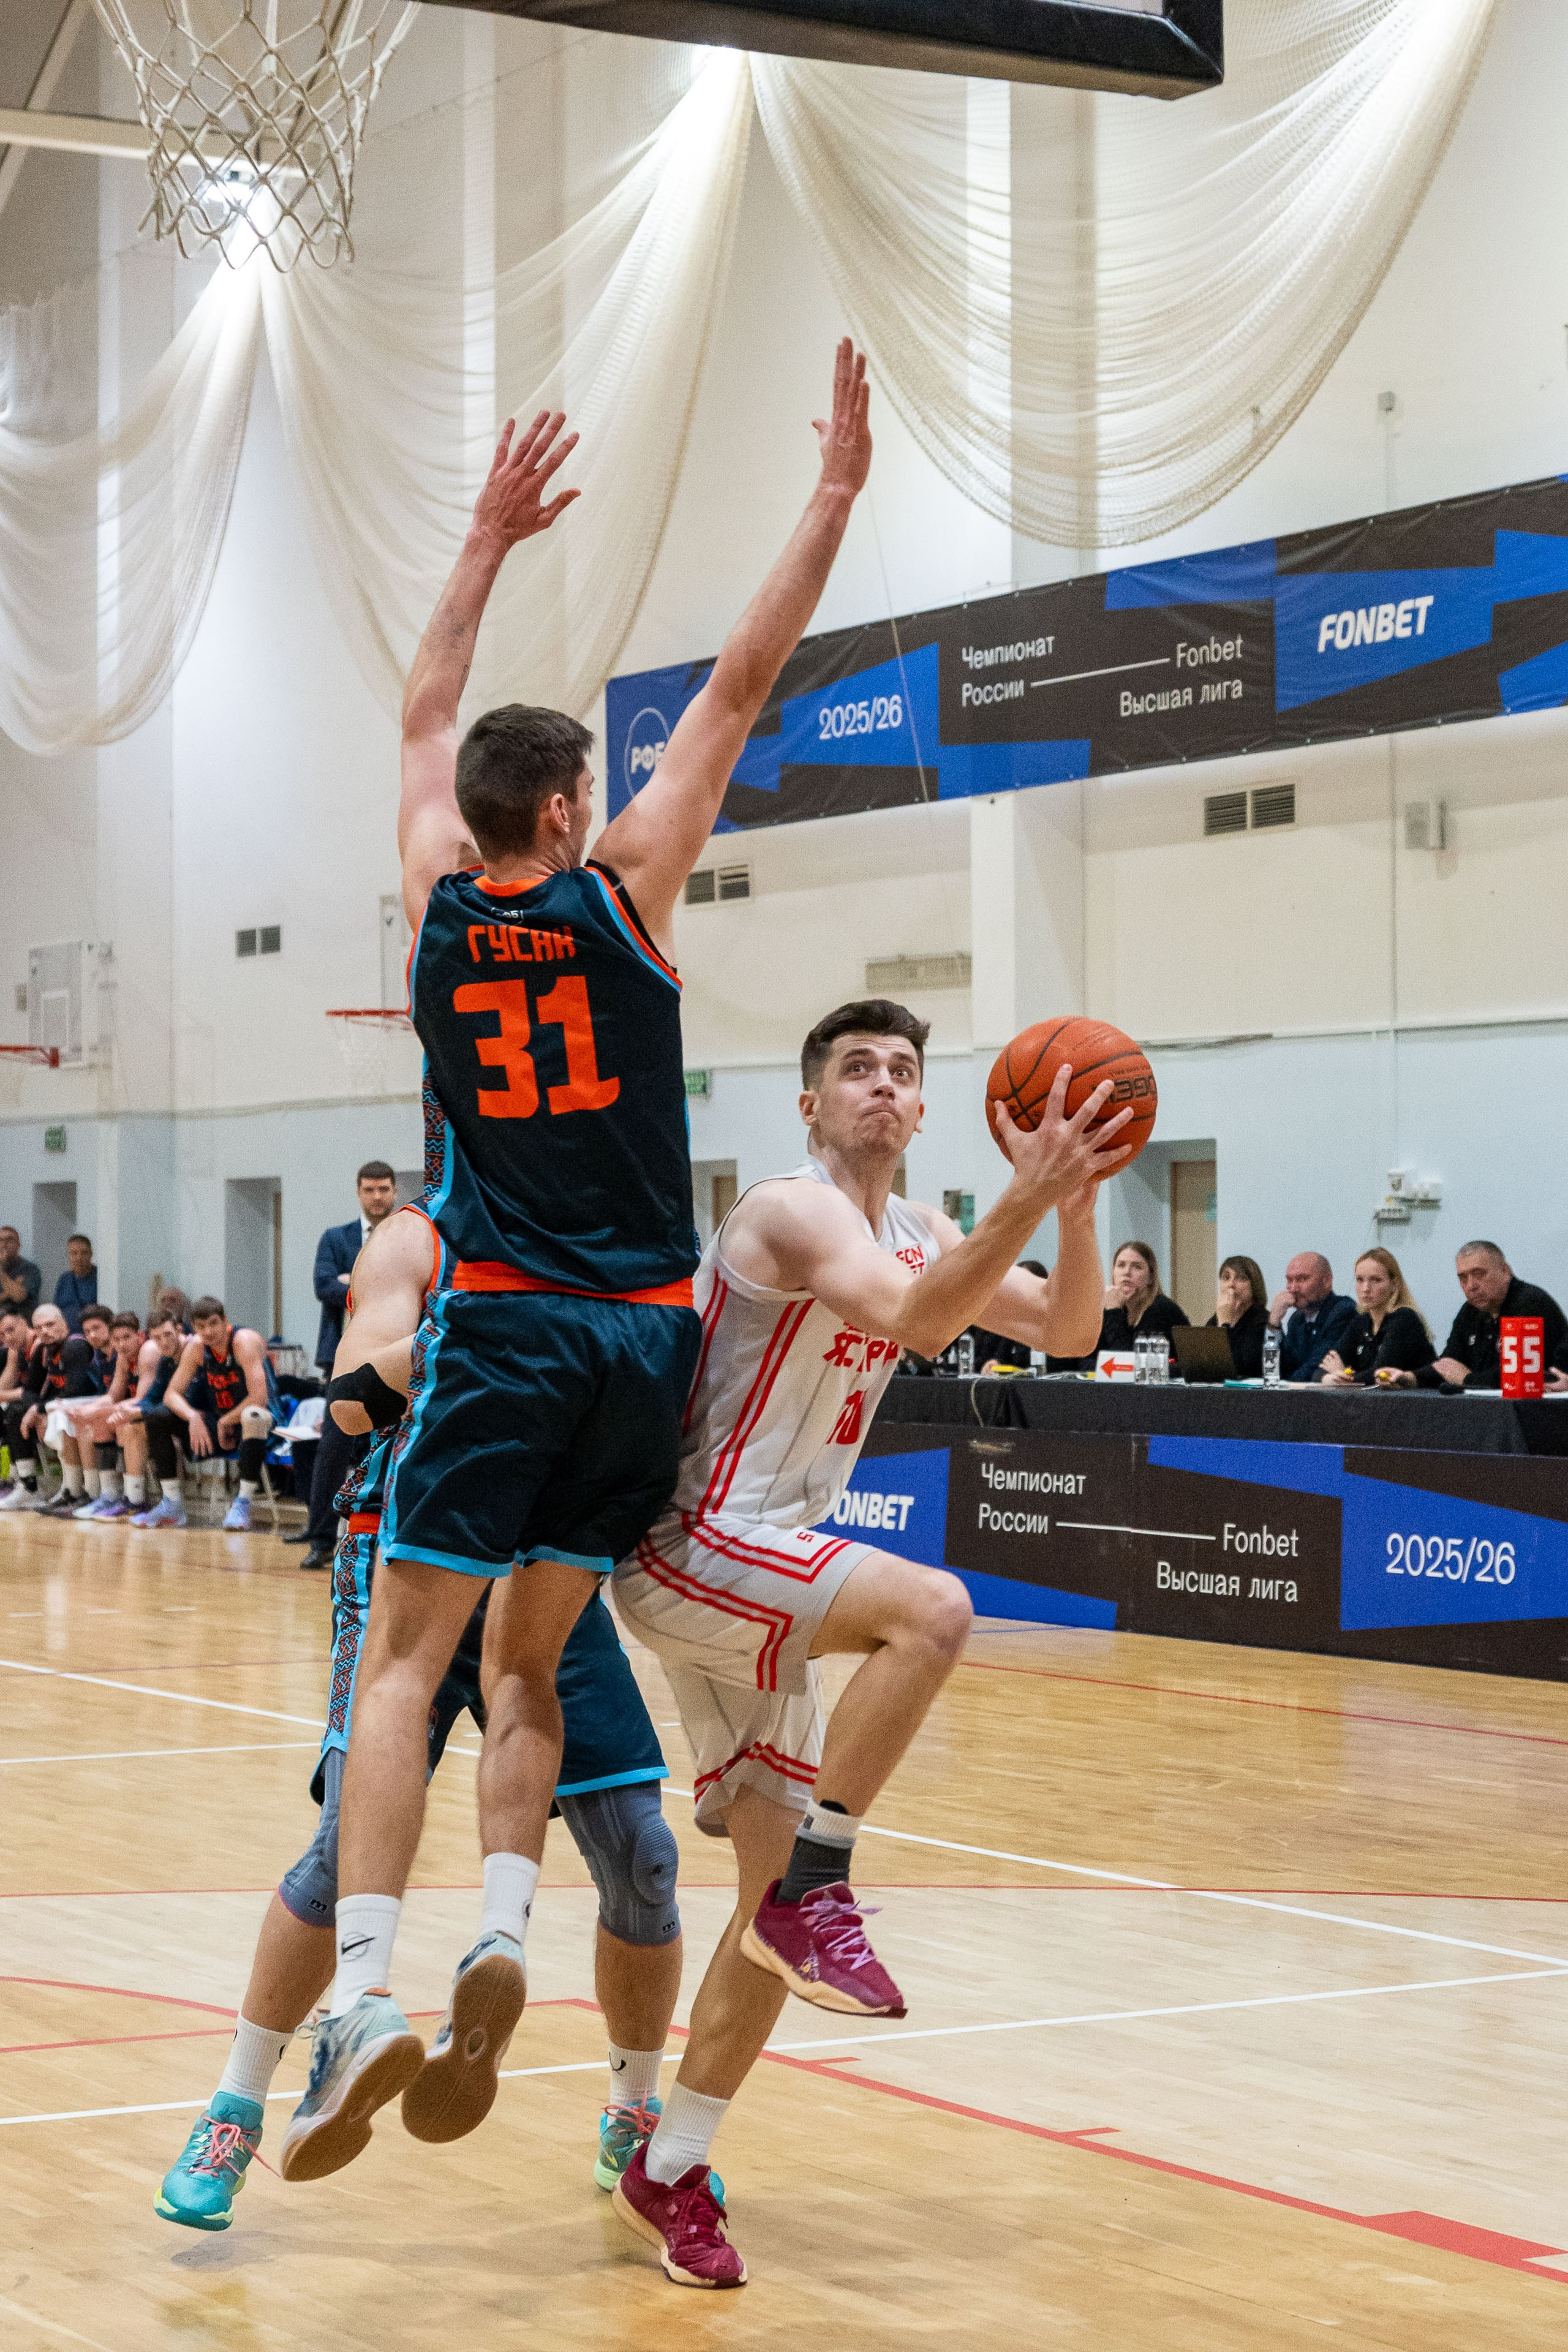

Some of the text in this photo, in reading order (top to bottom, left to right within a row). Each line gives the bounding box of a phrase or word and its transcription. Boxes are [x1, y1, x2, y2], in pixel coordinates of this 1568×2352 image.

[1317, 595, 1434, 653] FONBET
[962, 636, 1055, 669] Чемпионат
[1176, 633, 1243, 668] Fonbet
[961, 679, 1025, 707] России
[1120, 679, 1243, 717] Высшая лига
[819, 695, 902, 739] 2025/26
[453, 976, 620, 1118] 31
[981, 1461, 1087, 1494] Чемпионат
[833, 1490, 915, 1531] ONBET
[978, 1502, 1048, 1534] России
[1223, 1523, 1299, 1556] Fonbet
[1385, 1532, 1515, 1585] 2025/26
[1156, 1560, 1298, 1602] Высшая лига
